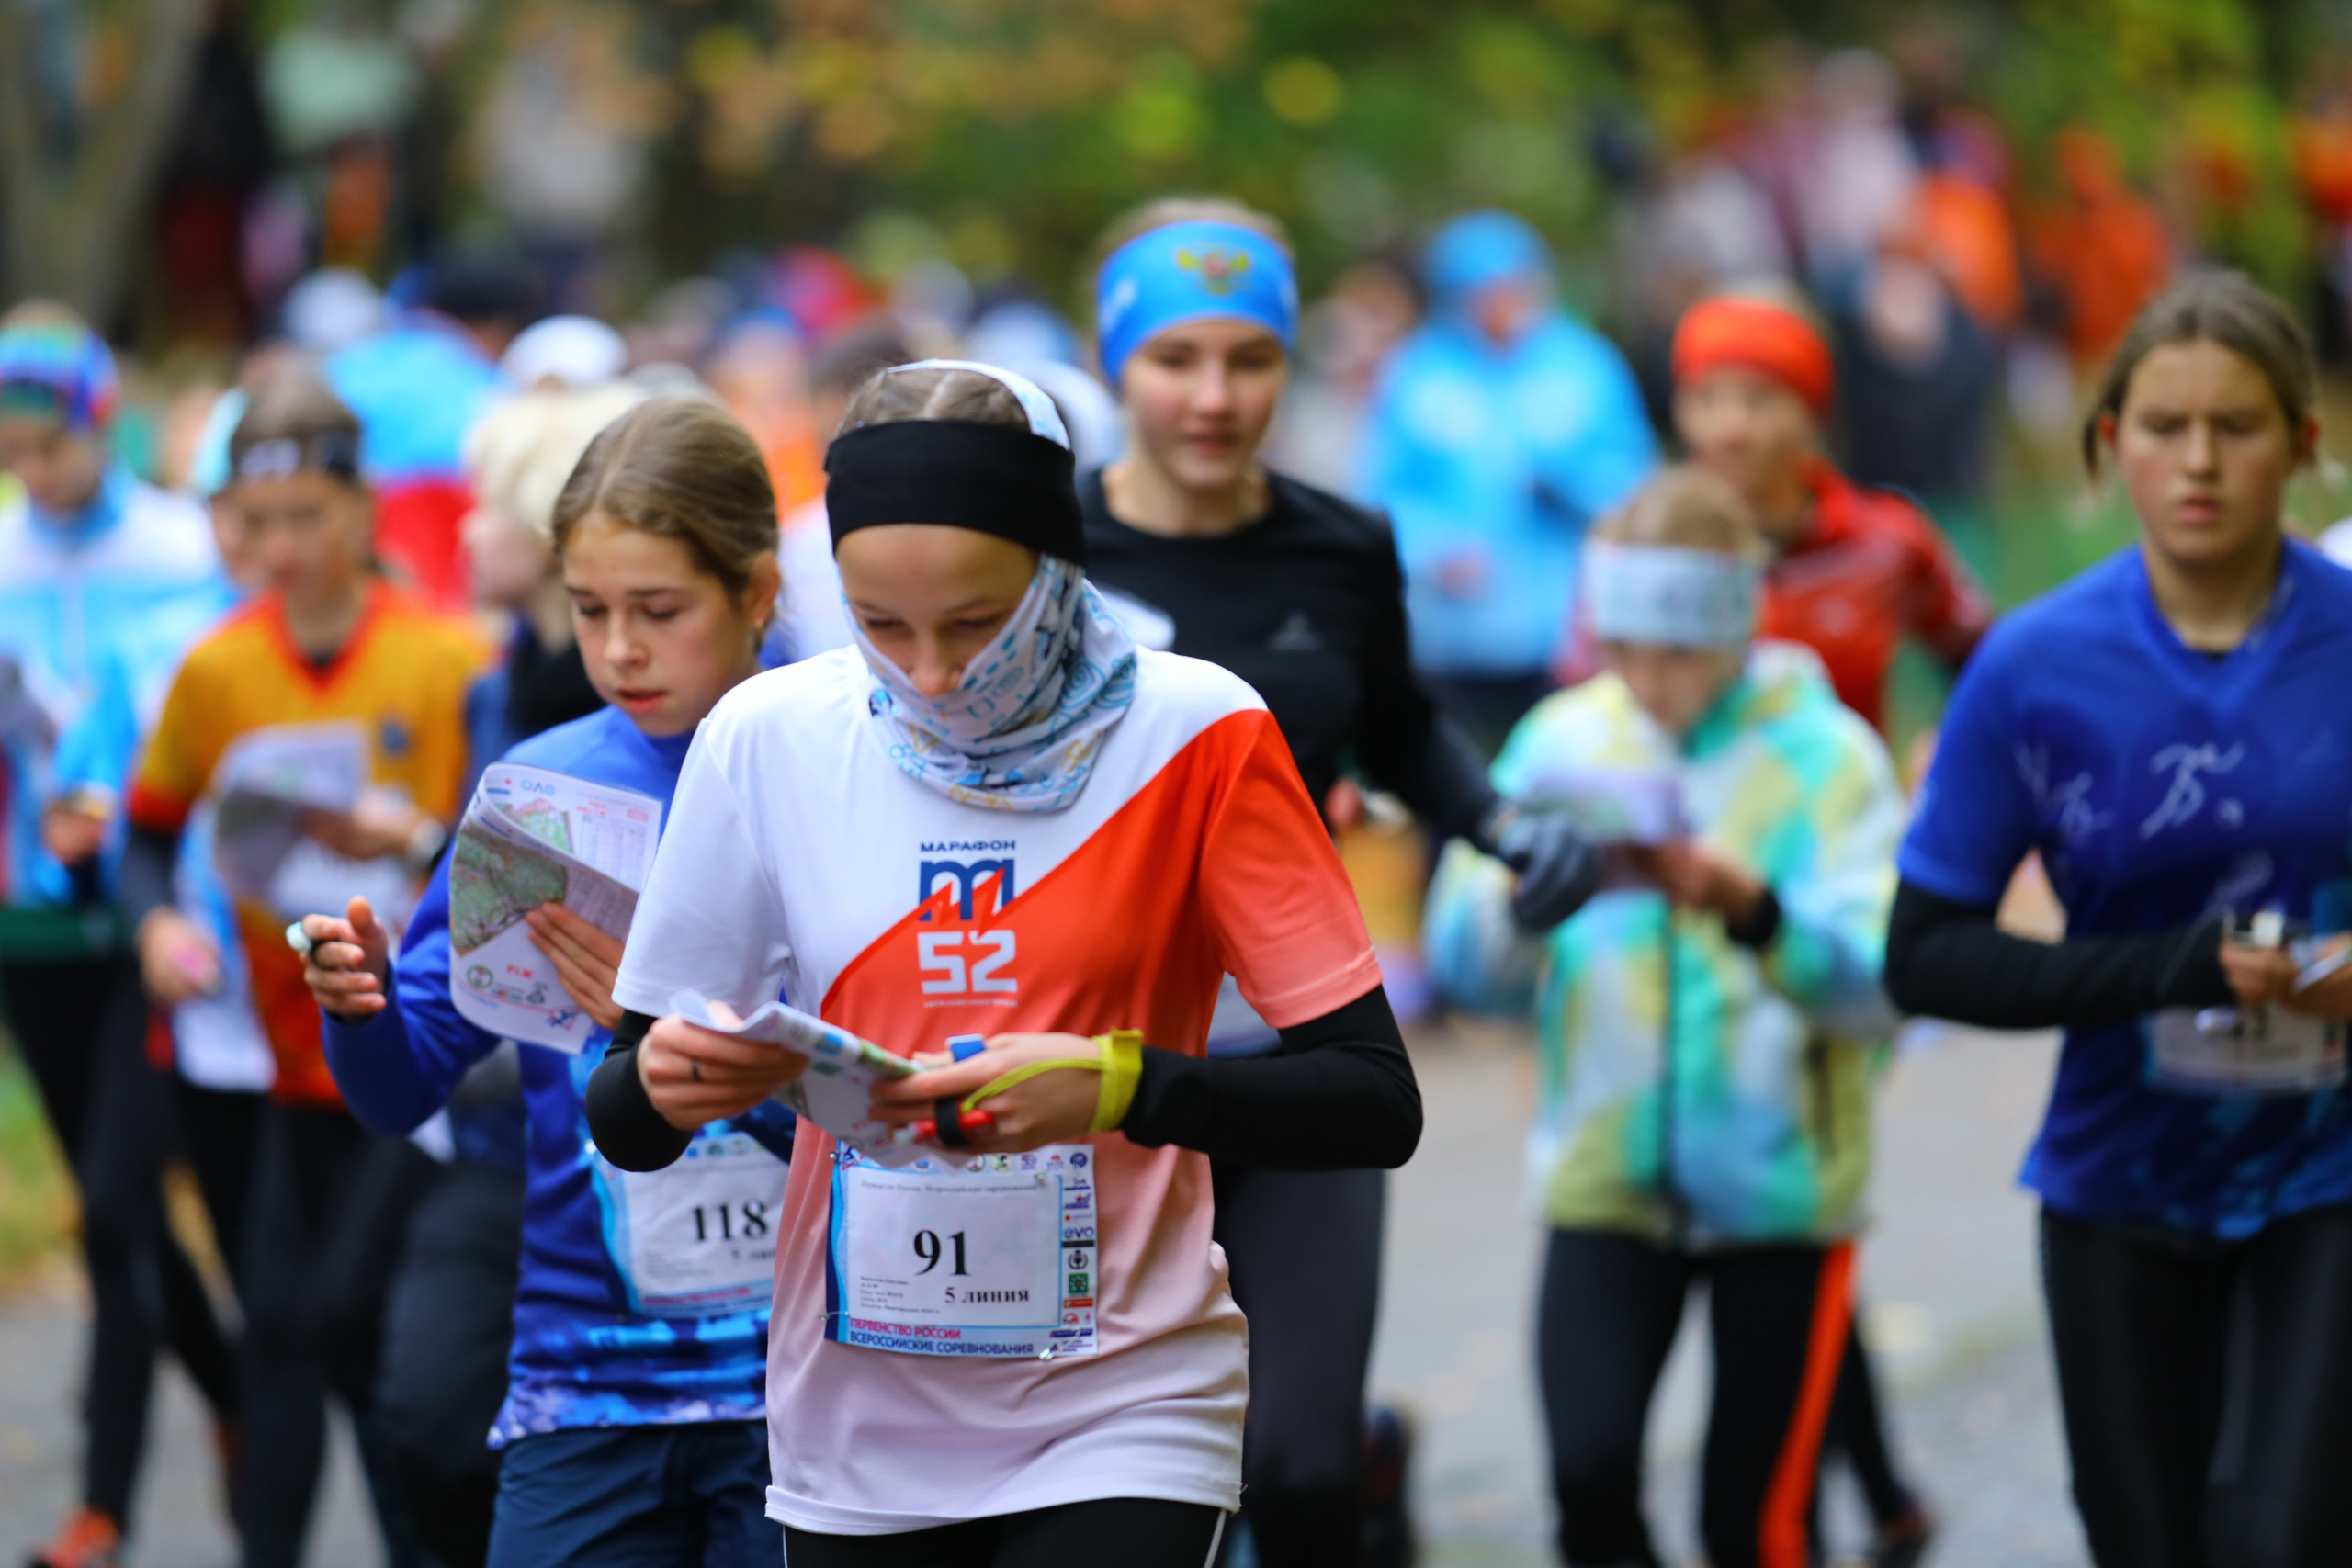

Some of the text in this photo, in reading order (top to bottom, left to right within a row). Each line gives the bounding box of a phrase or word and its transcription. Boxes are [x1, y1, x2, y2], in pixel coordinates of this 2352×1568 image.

[920, 840, 1016, 852] МАРАФОН
[917, 929, 1019, 994] 52
[693, 1198, 768, 1243] 118
[1064, 1227, 1094, 1240] evo
[913, 1228, 970, 1277] 91
[944, 1286, 1029, 1304] 5 линия
[850, 1318, 962, 1339] ПЕРВЕНСТВО РОССИИ
[936, 1341, 1035, 1355] СОРЕВНОВАНИЯ
